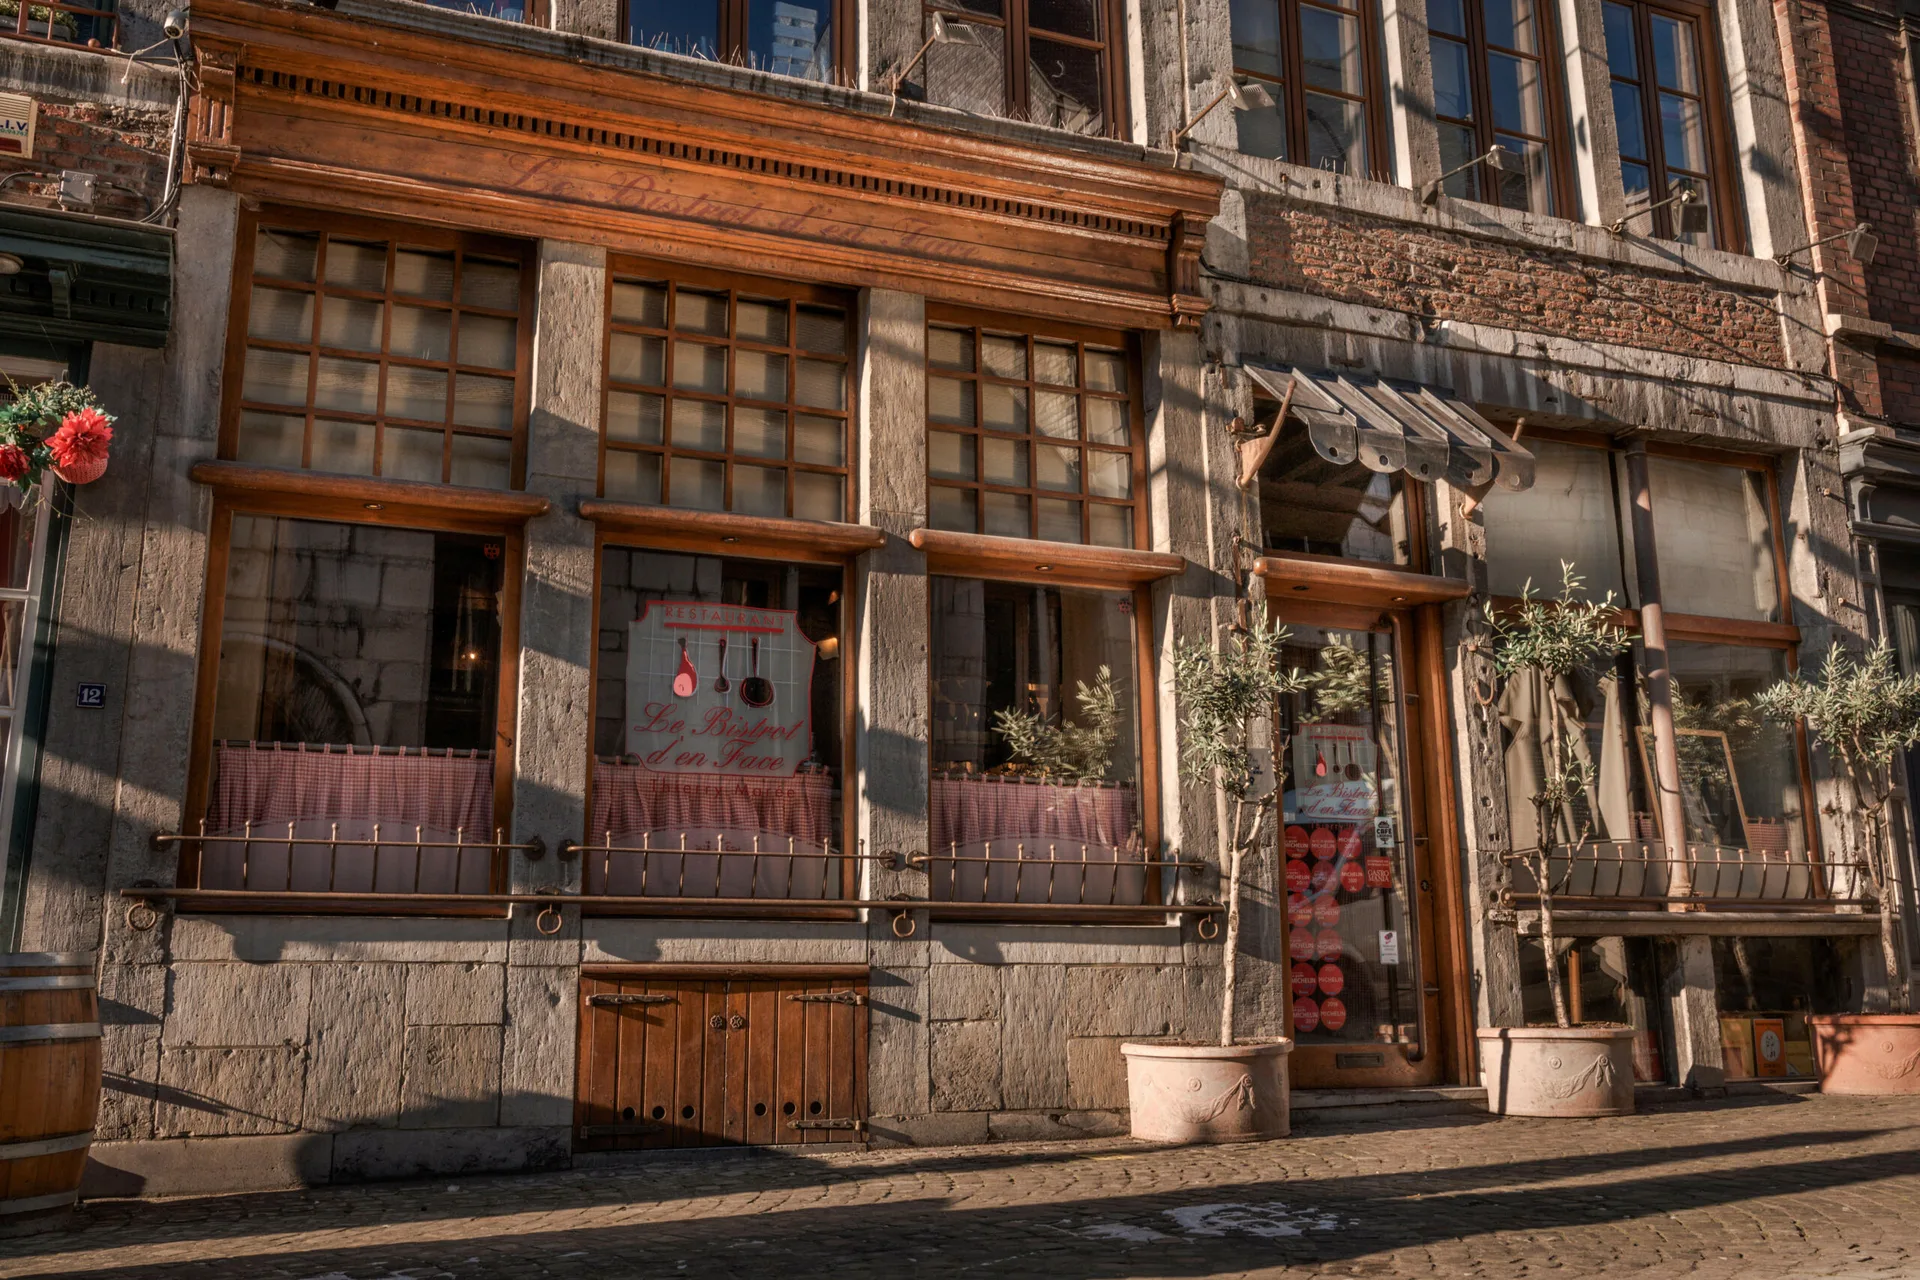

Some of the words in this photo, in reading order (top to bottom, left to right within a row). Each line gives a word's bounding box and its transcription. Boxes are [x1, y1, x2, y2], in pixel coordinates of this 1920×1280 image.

[502, 152, 575, 197] Le
[588, 170, 763, 227] Bistrot
[880, 216, 981, 260] Face
[664, 605, 785, 626] RESTAURANT
[82, 688, 101, 703] 12
[633, 702, 685, 735] Le
[692, 706, 804, 741] Bistrot
[646, 735, 709, 767] d'en
[713, 738, 785, 771] Face
[650, 778, 724, 798] Thierry
[1299, 779, 1324, 797] Le
[1326, 780, 1377, 799] Bistrot
[1337, 798, 1370, 816] Face
